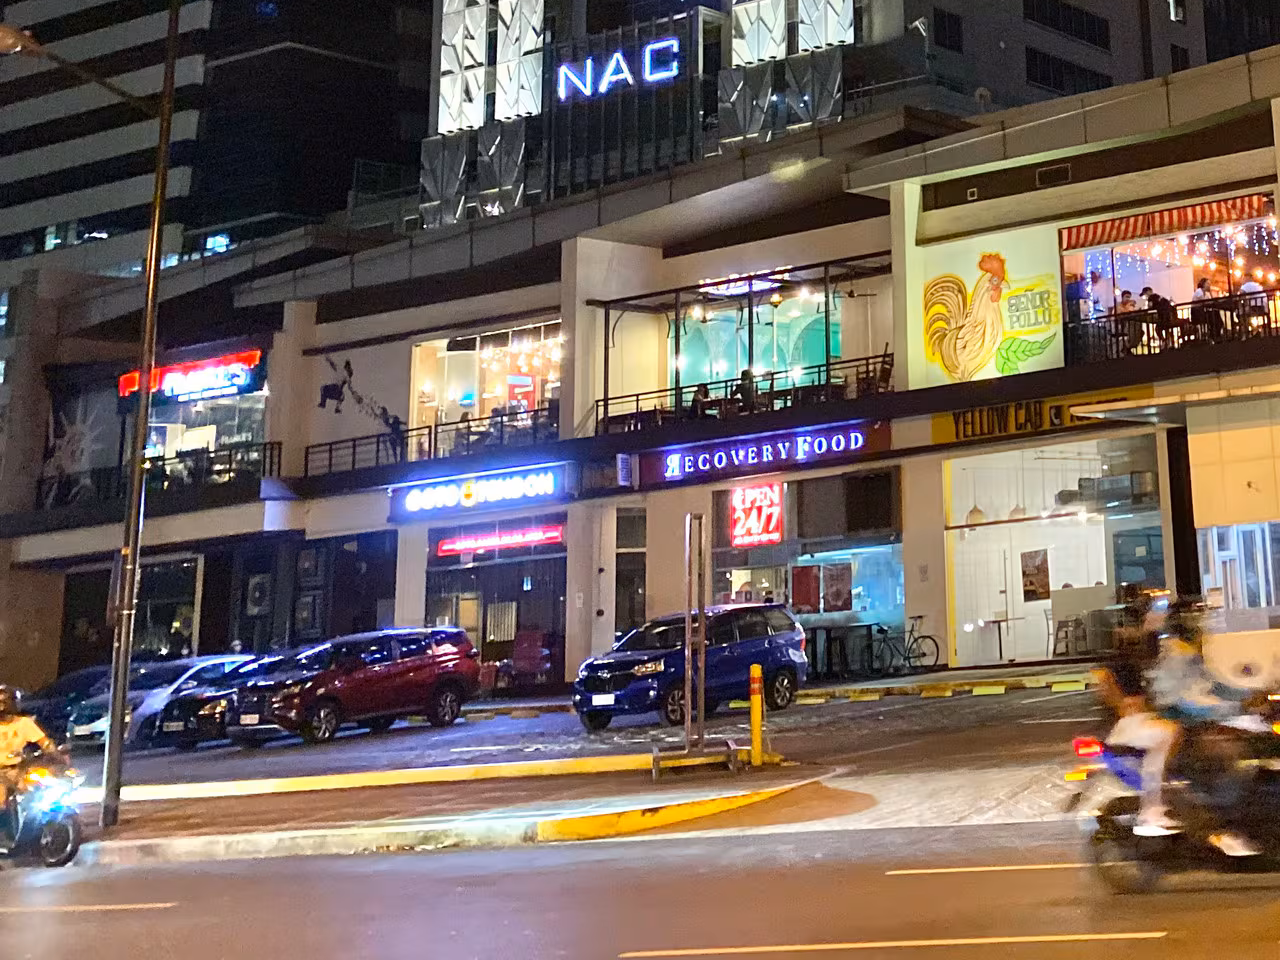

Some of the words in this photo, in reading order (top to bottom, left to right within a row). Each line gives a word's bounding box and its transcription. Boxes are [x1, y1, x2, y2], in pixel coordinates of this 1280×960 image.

[557, 38, 680, 100] NAC
[1008, 308, 1052, 329] POLLO
[952, 404, 1009, 441] YELLOW
[1013, 400, 1042, 431] CAB
[796, 431, 864, 460] FOOD
[733, 484, 780, 510] OPEN
[734, 506, 781, 536] 24/7
